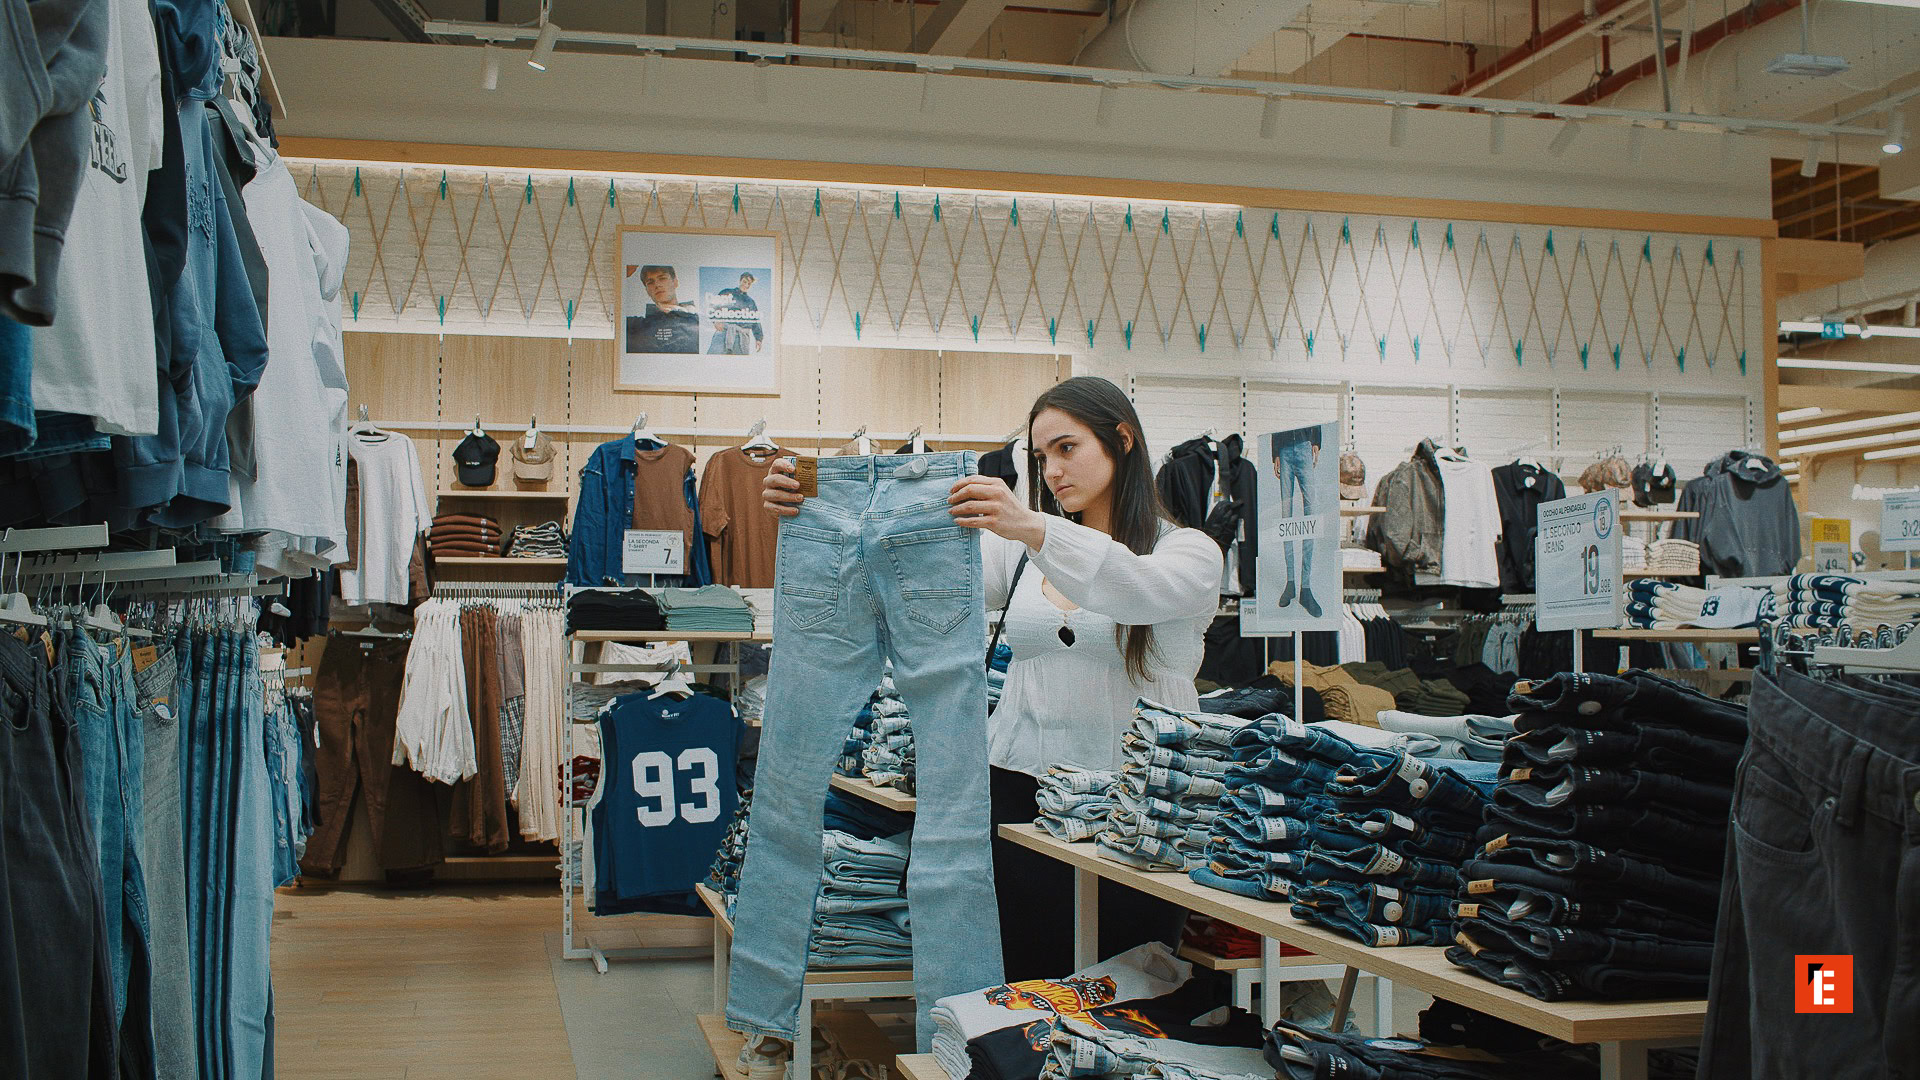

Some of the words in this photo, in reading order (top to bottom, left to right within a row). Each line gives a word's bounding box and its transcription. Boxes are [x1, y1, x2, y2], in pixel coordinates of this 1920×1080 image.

[1278, 520, 1317, 538] SKINNY
[1549, 521, 1582, 539] SECONDO
[1543, 539, 1565, 554] JEANS
[663, 548, 672, 565] 7
[1701, 600, 1719, 617] 83
[1759, 598, 1777, 617] 83
[632, 747, 721, 828] 93
